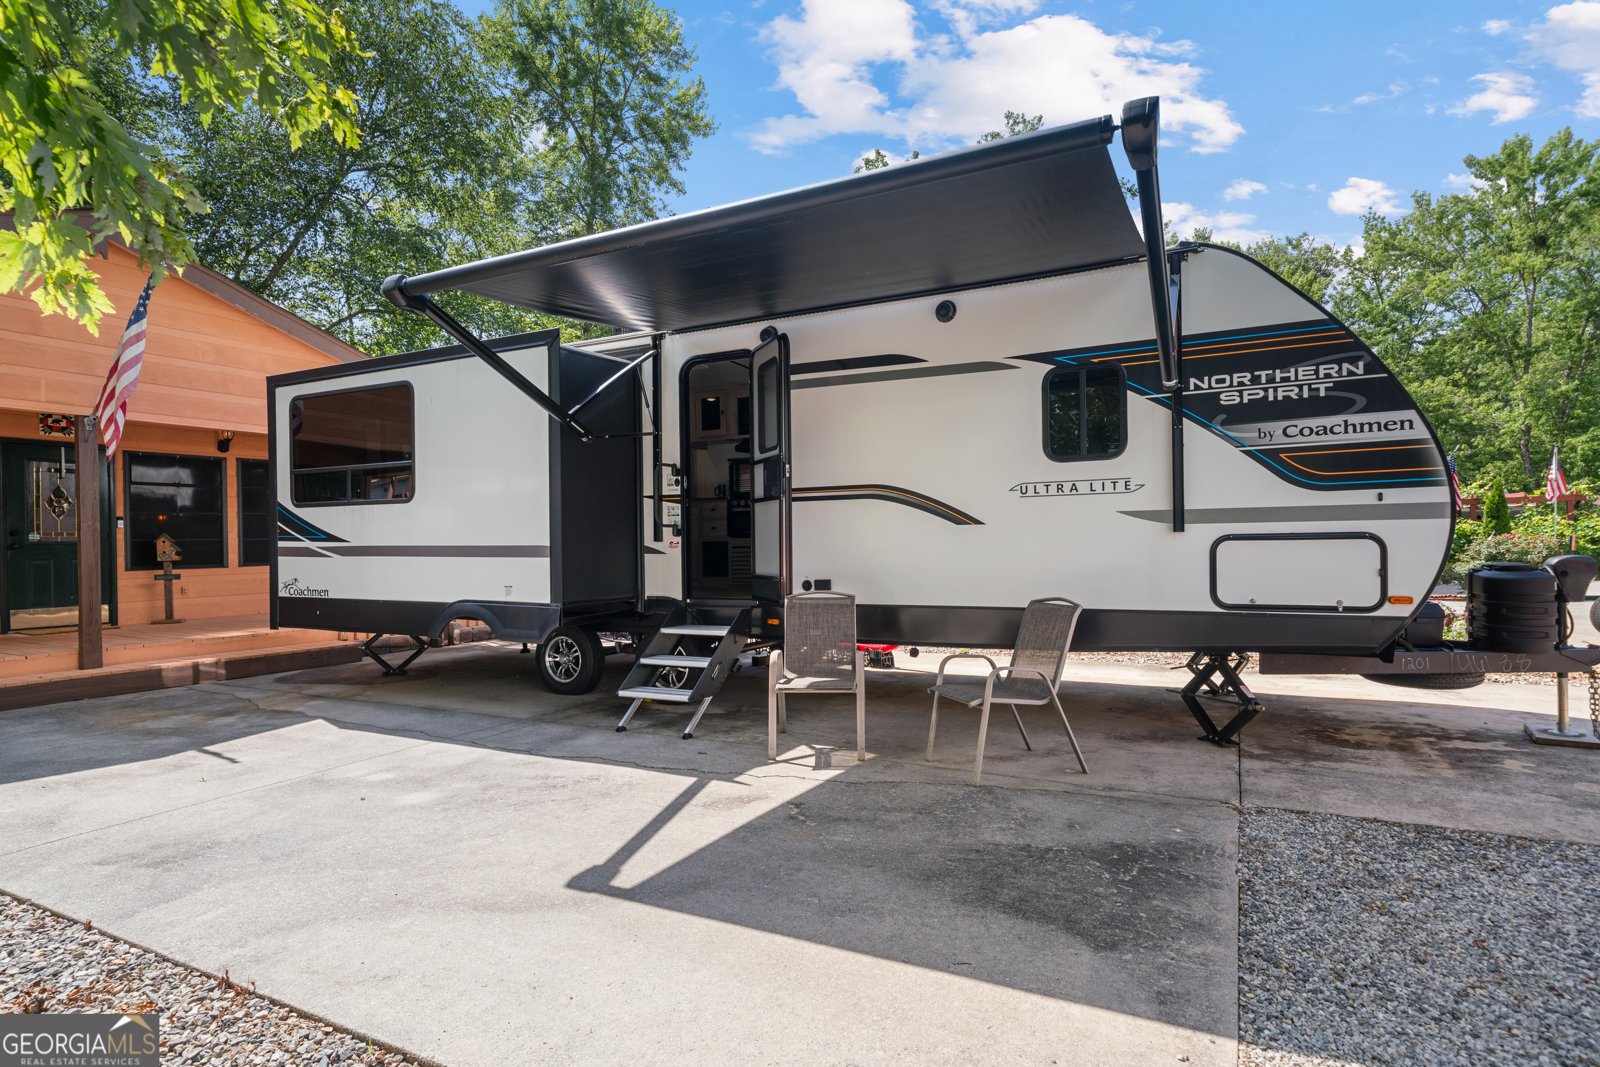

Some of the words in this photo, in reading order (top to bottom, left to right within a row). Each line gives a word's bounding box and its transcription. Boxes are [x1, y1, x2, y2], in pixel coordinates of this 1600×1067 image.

[1189, 361, 1364, 390] NORTHERN
[1219, 383, 1333, 405] SPIRIT
[1257, 428, 1275, 442] by
[1282, 418, 1414, 438] Coachmen
[1020, 483, 1079, 495] ULTRA
[1090, 480, 1131, 492] LITE
[288, 586, 329, 597] Coachmen
